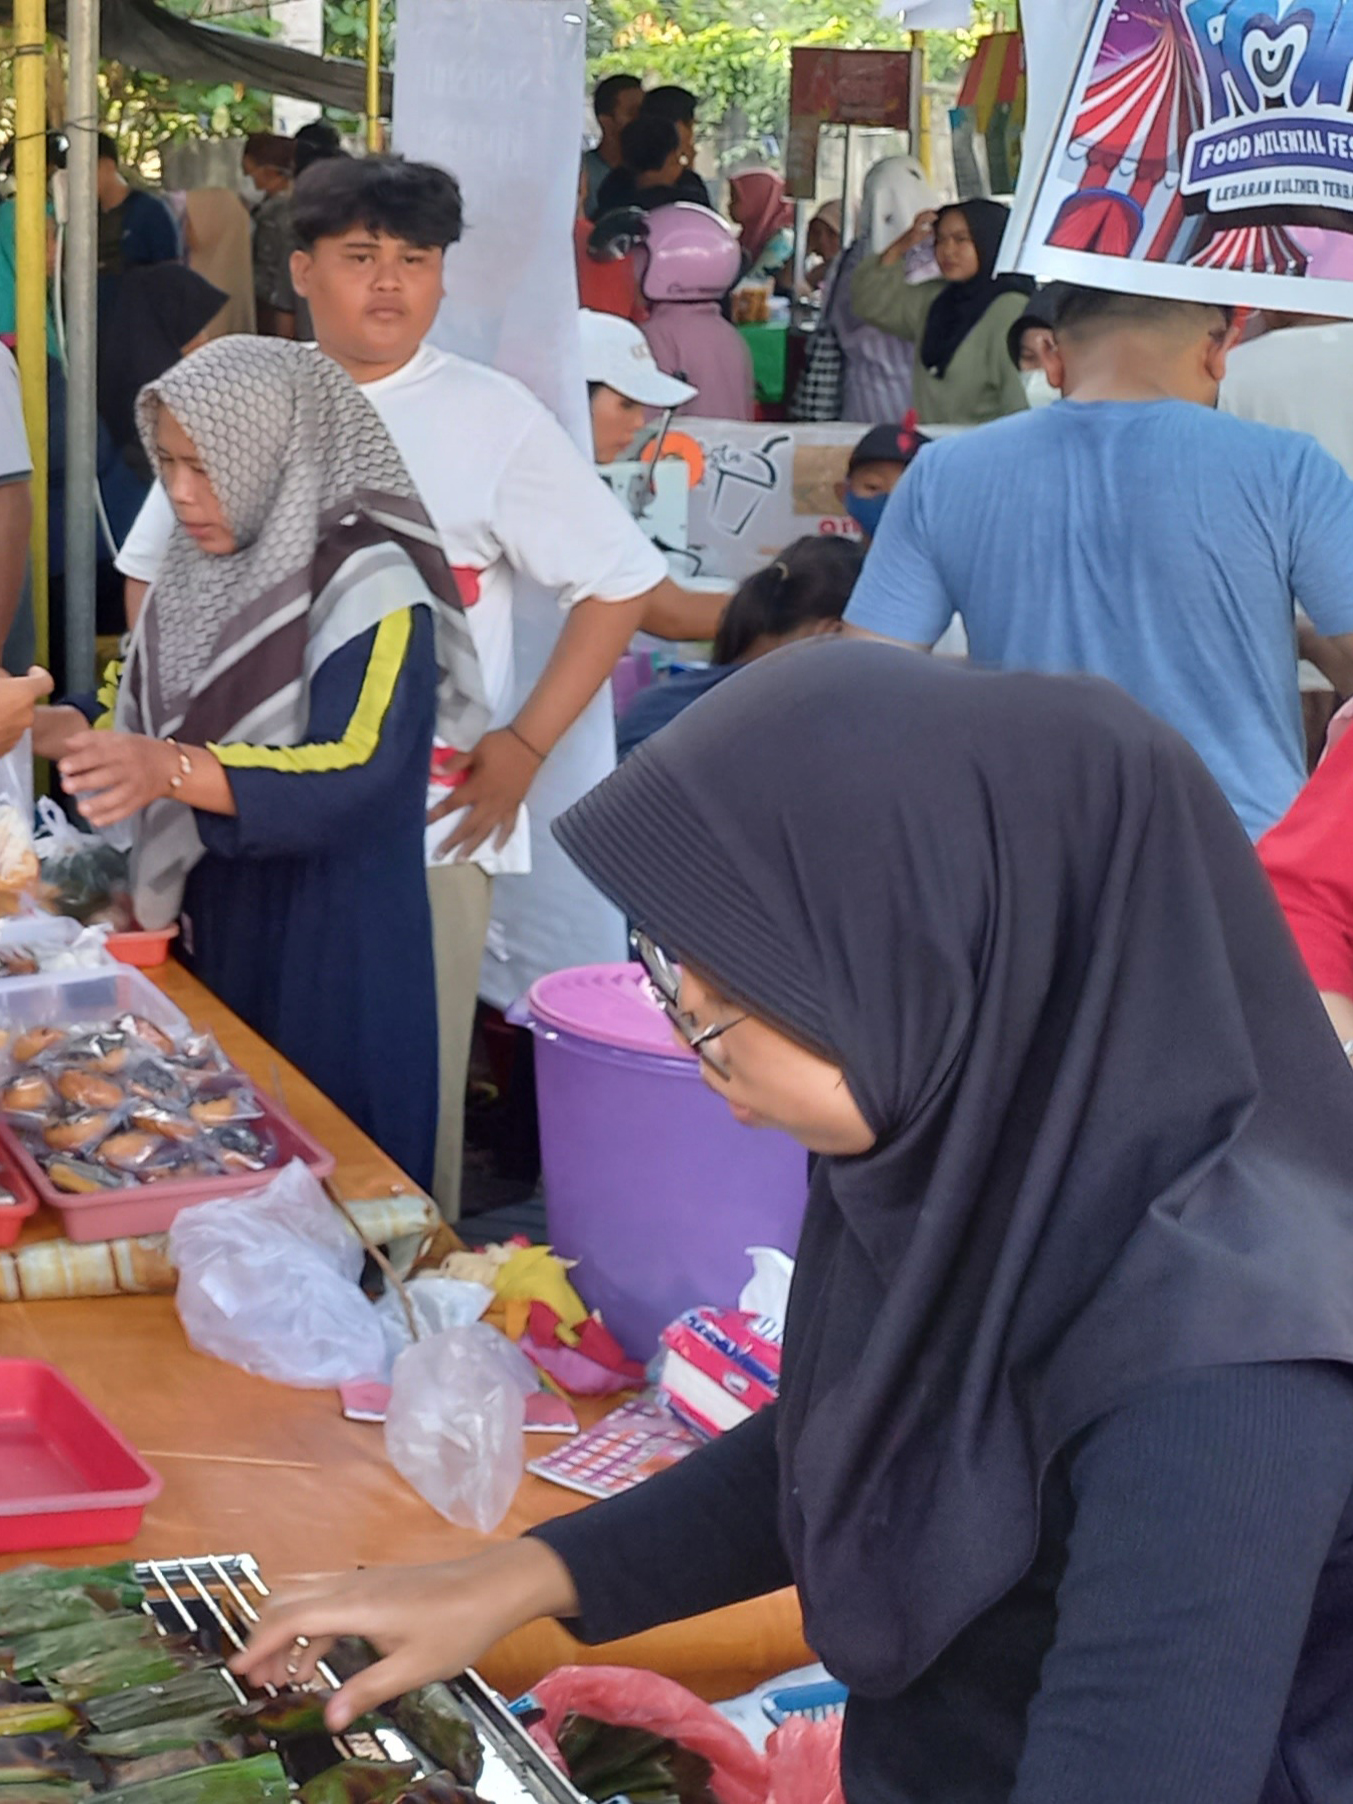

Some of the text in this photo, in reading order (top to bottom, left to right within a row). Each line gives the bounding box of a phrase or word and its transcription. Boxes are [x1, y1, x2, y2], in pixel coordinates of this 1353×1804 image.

[1199, 135, 1252, 169] FOOD
[1253, 129, 1326, 157] MILENIAL
[1215, 178, 1353, 202] LEBARAN KULINER TERB
